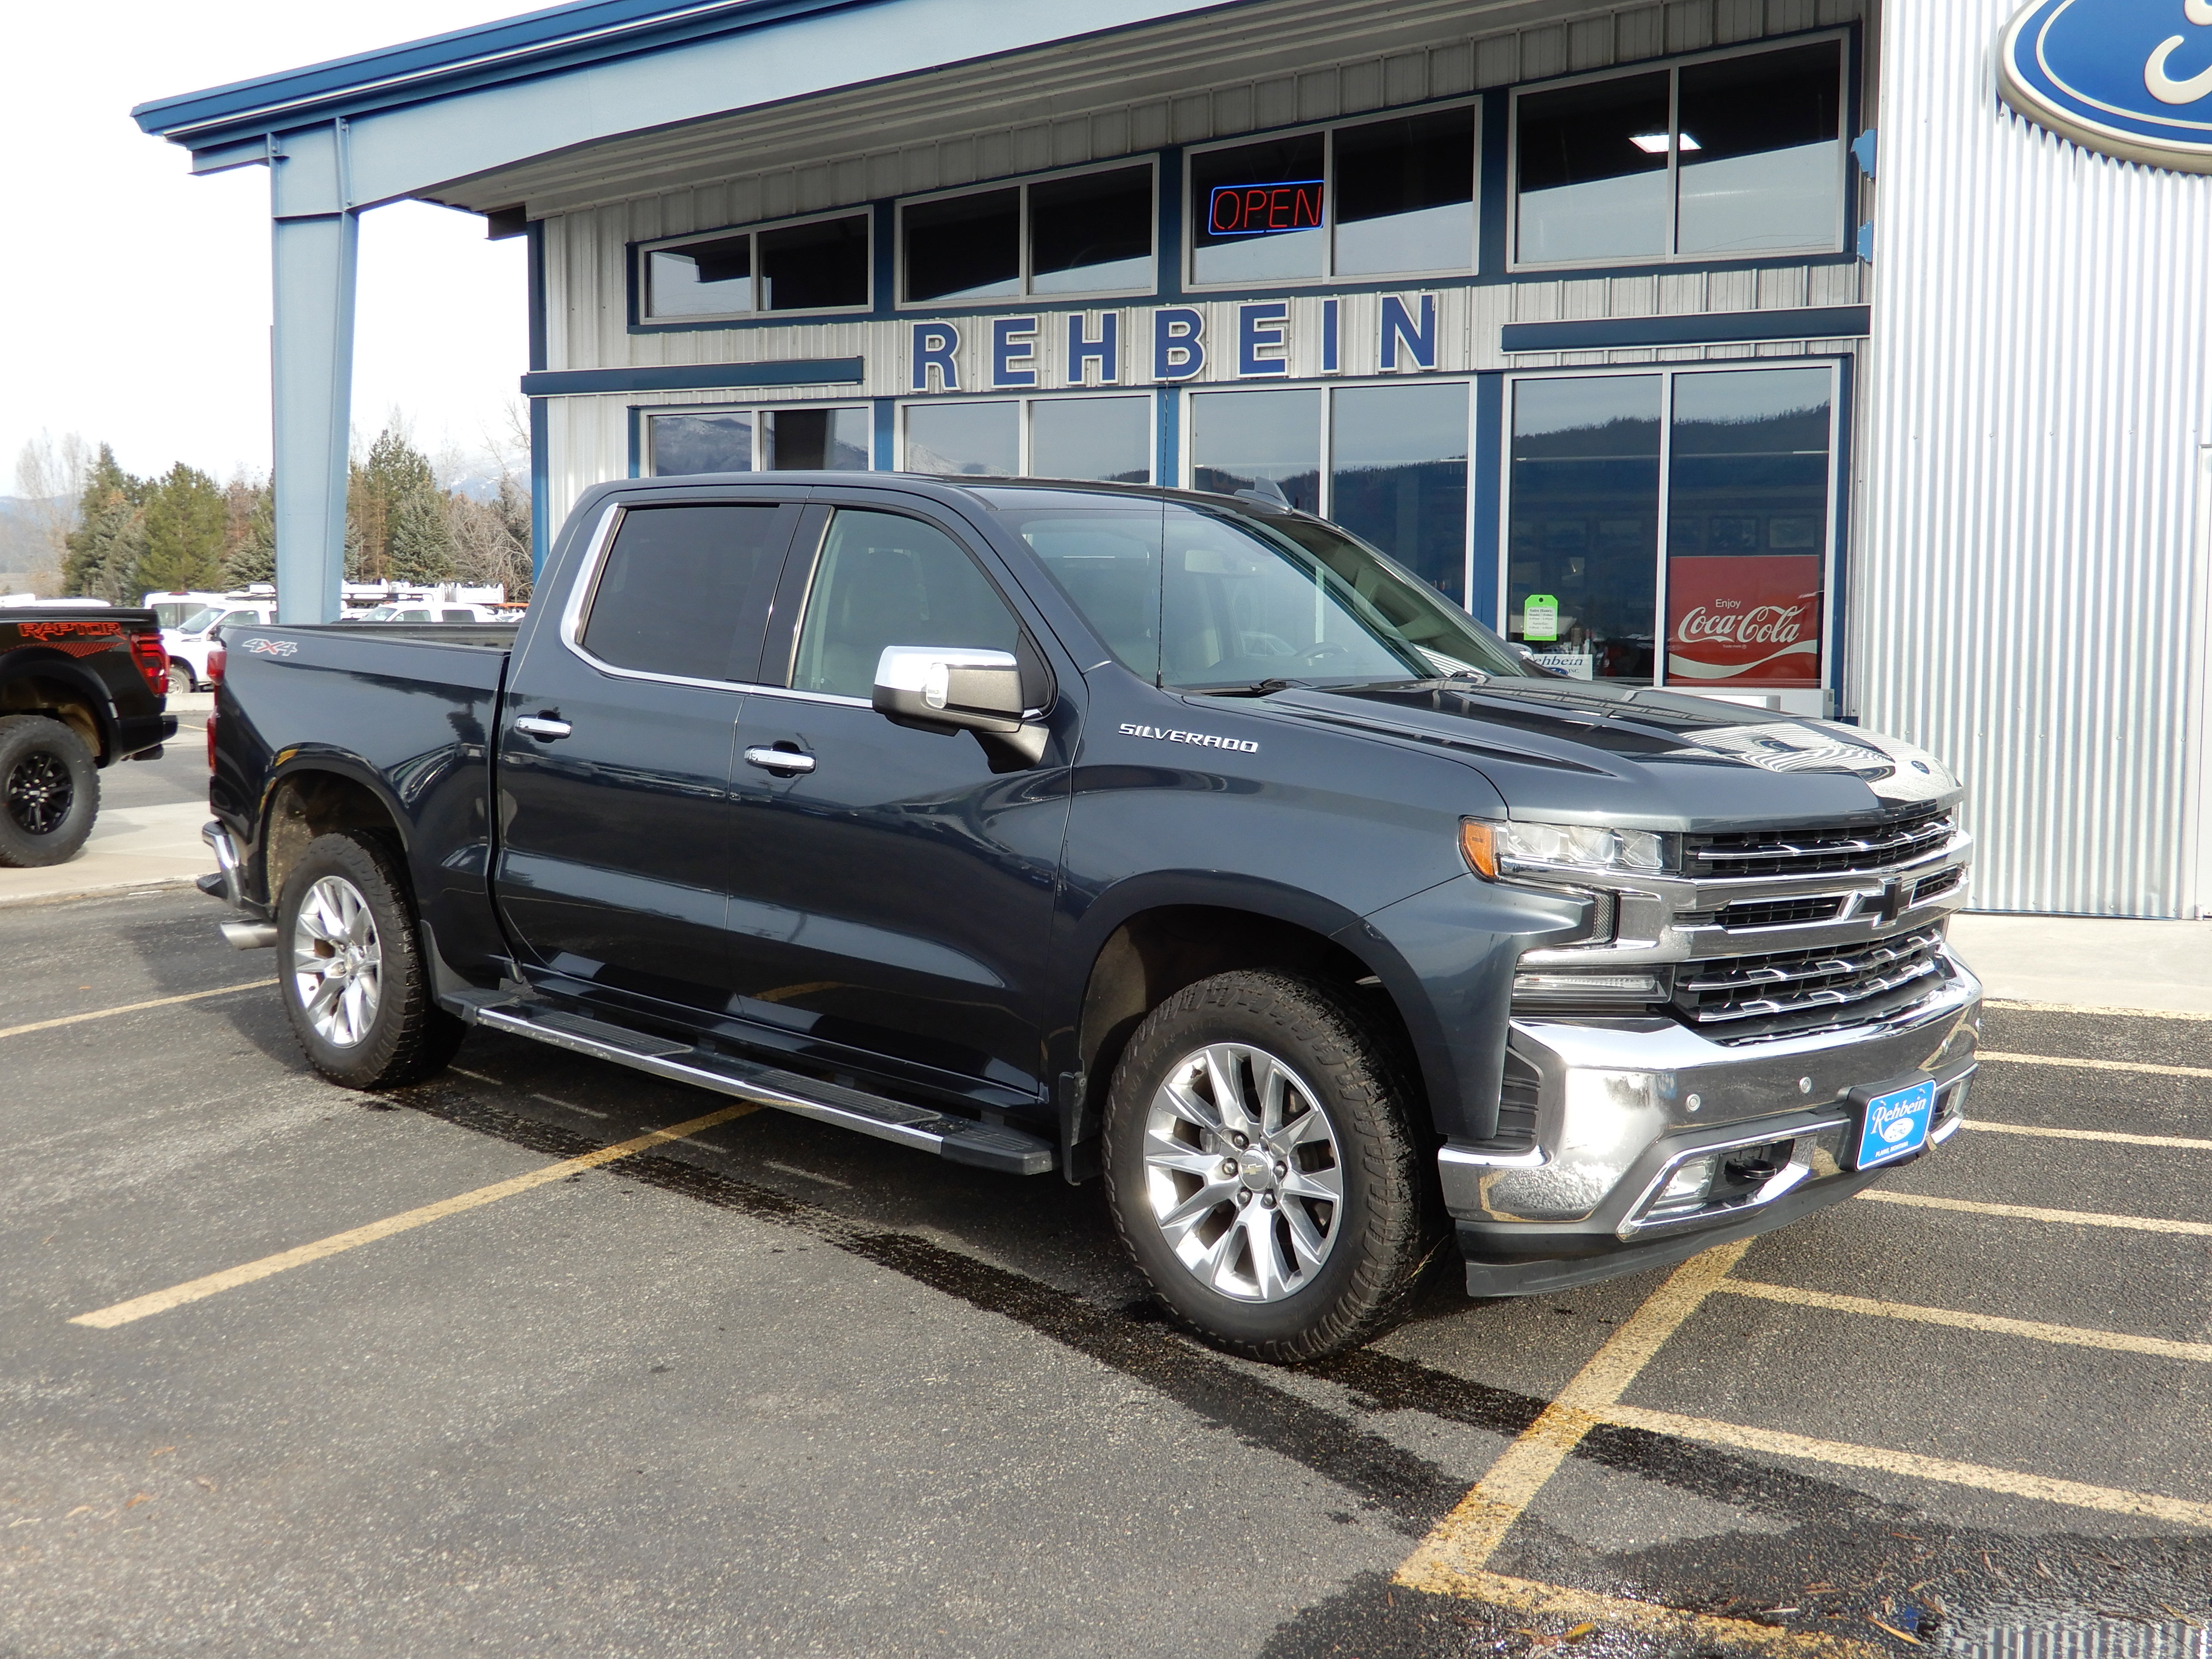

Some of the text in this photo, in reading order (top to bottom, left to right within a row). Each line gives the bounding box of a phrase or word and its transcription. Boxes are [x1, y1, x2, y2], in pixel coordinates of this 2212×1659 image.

[1214, 186, 1322, 230] OPEN
[910, 291, 1440, 392] REHBEIN
[1715, 599, 1741, 609] Enjoy
[17, 622, 128, 642] RAPTOR
[1677, 606, 1806, 643] Coca-Cola
[1534, 656, 1583, 666] ehbein
[1118, 723, 1259, 754] SILVERADO
[1870, 1097, 1927, 1138] Rehbein
